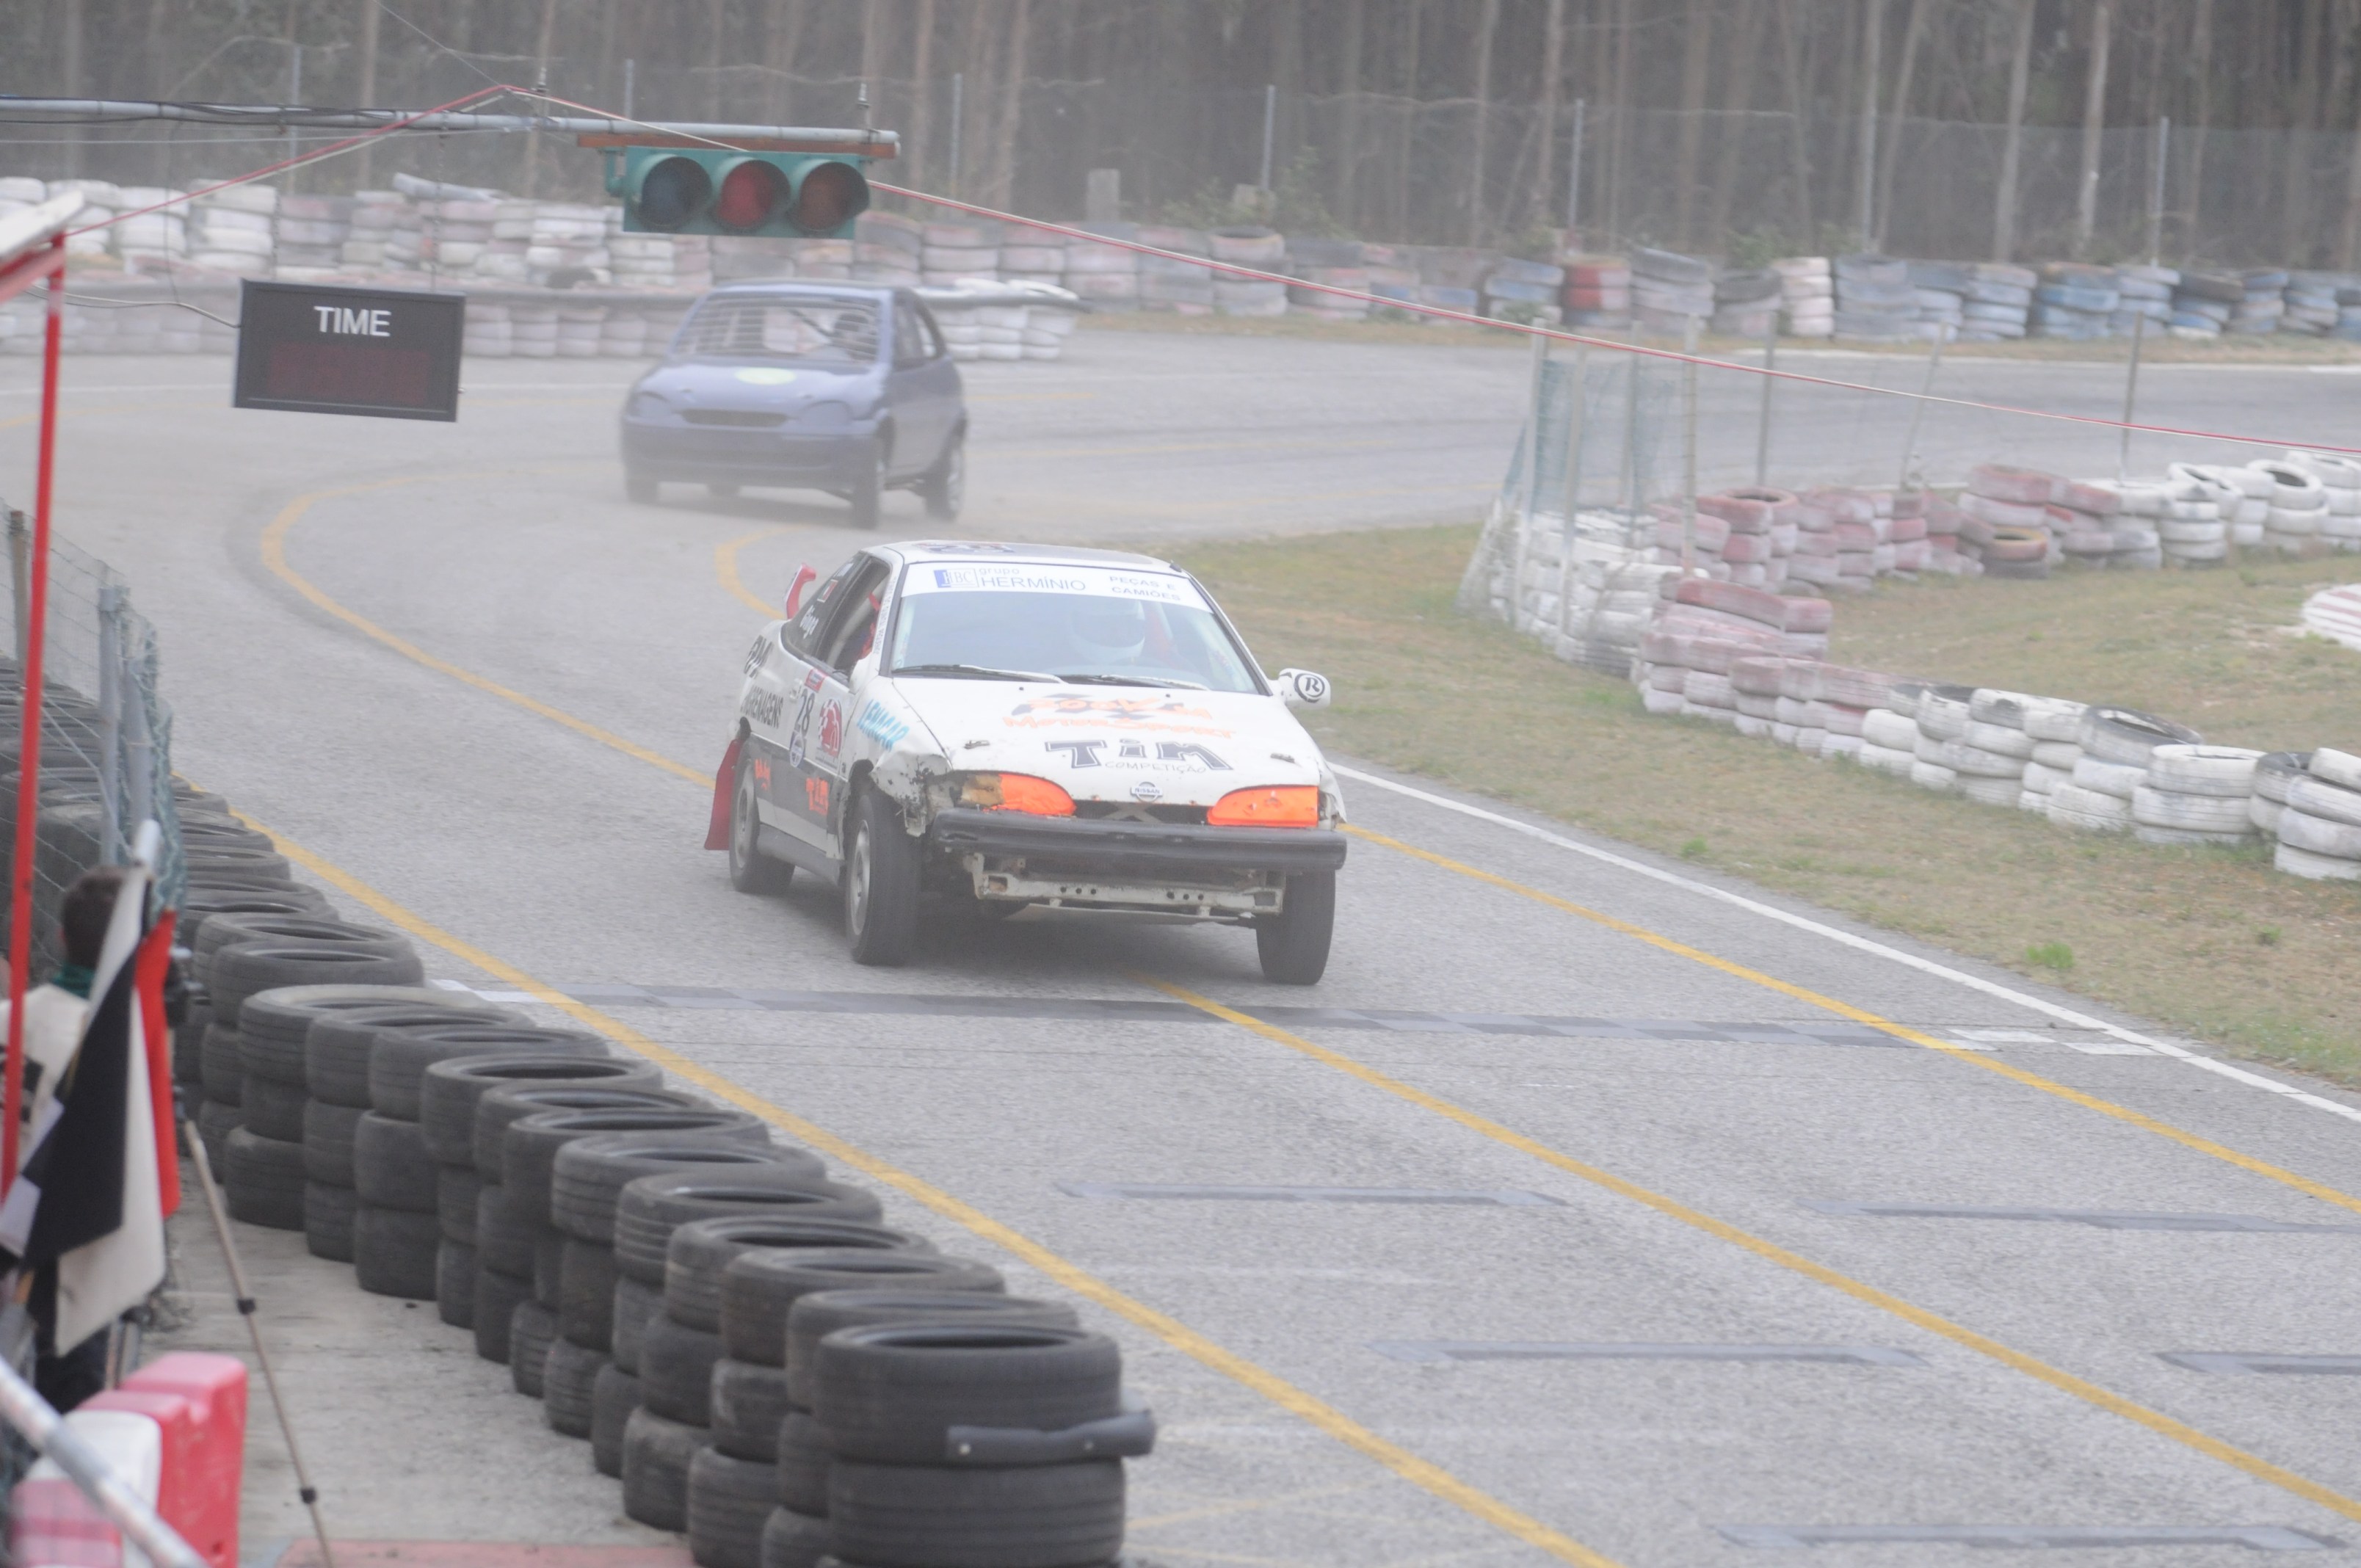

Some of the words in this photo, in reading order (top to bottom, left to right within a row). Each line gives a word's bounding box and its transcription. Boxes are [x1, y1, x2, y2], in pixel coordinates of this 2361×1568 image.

[313, 305, 392, 337] TIME
[979, 567, 1020, 576] grupo
[982, 576, 1087, 591] HERMÍNIO
[794, 689, 815, 736] 28
